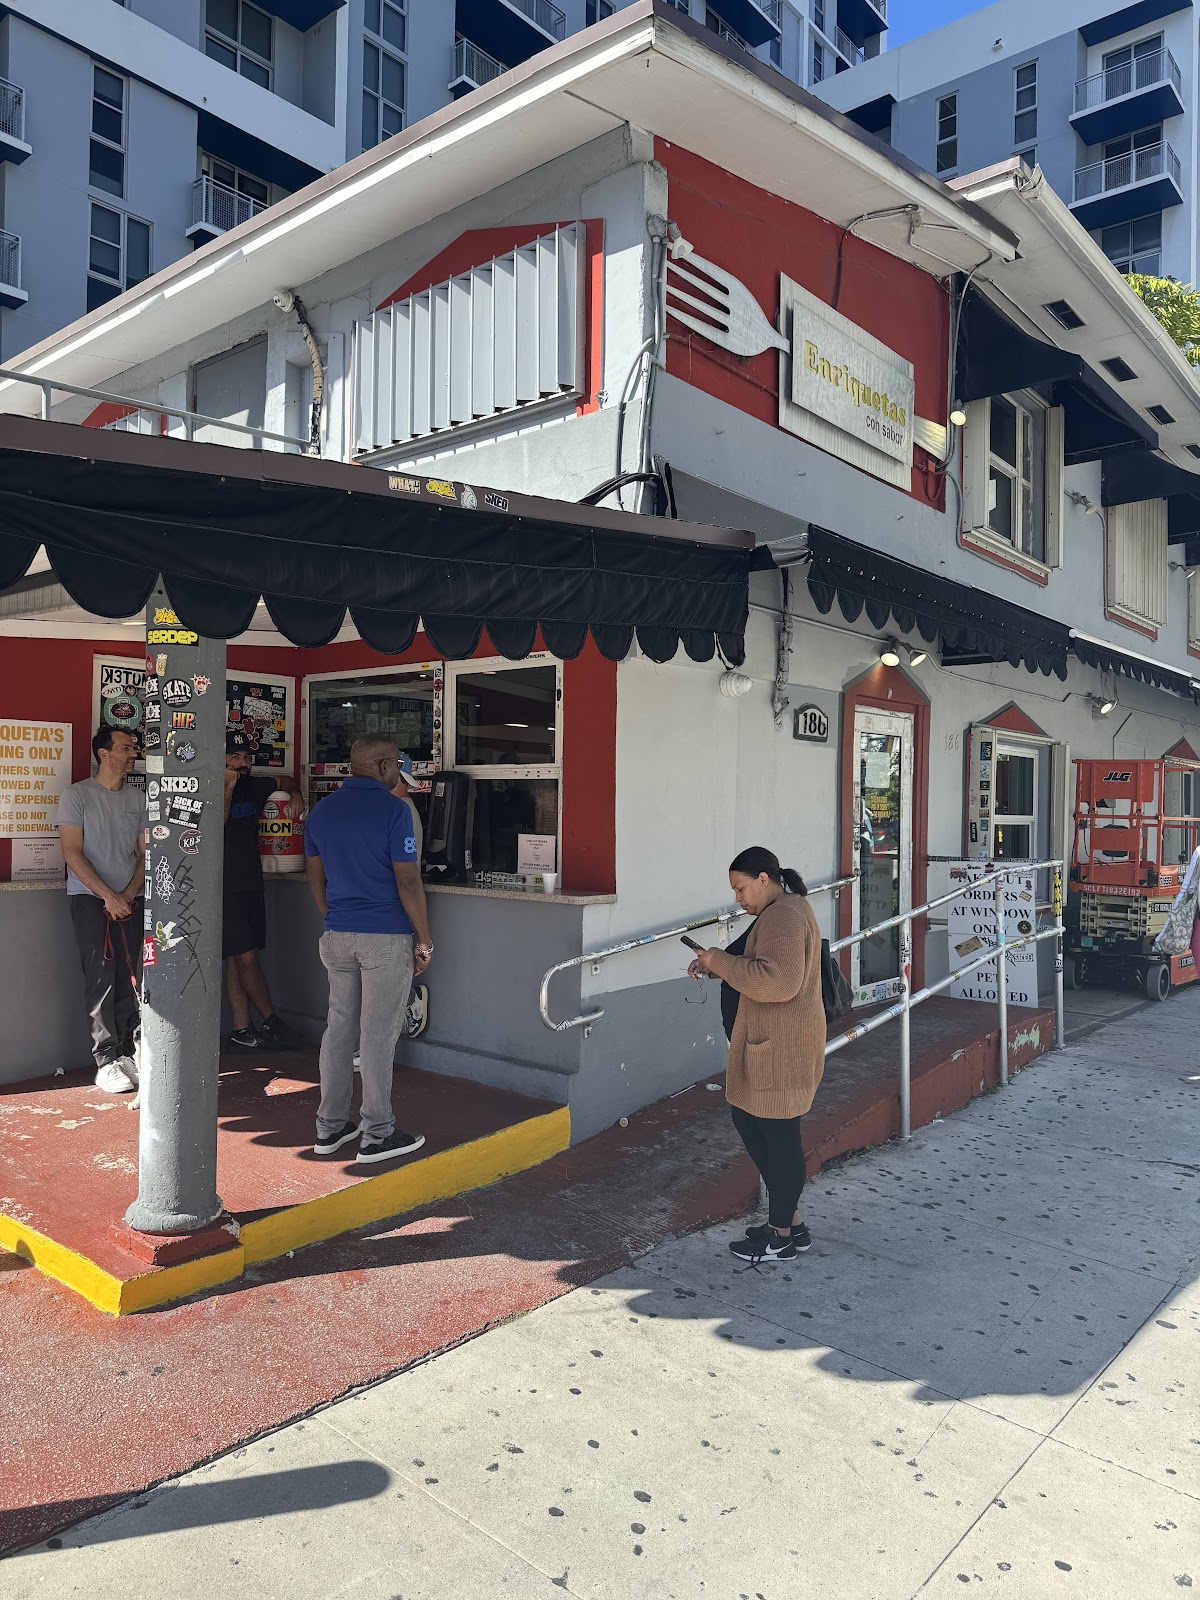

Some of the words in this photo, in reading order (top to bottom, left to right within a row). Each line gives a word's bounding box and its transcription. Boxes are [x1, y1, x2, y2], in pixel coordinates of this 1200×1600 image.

[805, 340, 906, 427] Enriquetas
[866, 415, 880, 434] con
[882, 423, 903, 446] sabor
[163, 680, 192, 700] SKATE
[803, 712, 826, 736] 186
[28, 746, 64, 760] ONLY
[33, 767, 56, 776] WILL
[1104, 771, 1132, 782] JLG
[0, 780, 31, 790] OWED
[33, 781, 46, 790] AT
[14, 795, 60, 805] EXPENSE
[173, 796, 193, 808] SICK
[193, 800, 203, 810] OF
[16, 812, 28, 820] DO
[30, 812, 48, 820] NOT
[258, 822, 291, 834] ILON
[951, 906, 967, 916] AT
[960, 988, 1028, 1002] ALLOED
